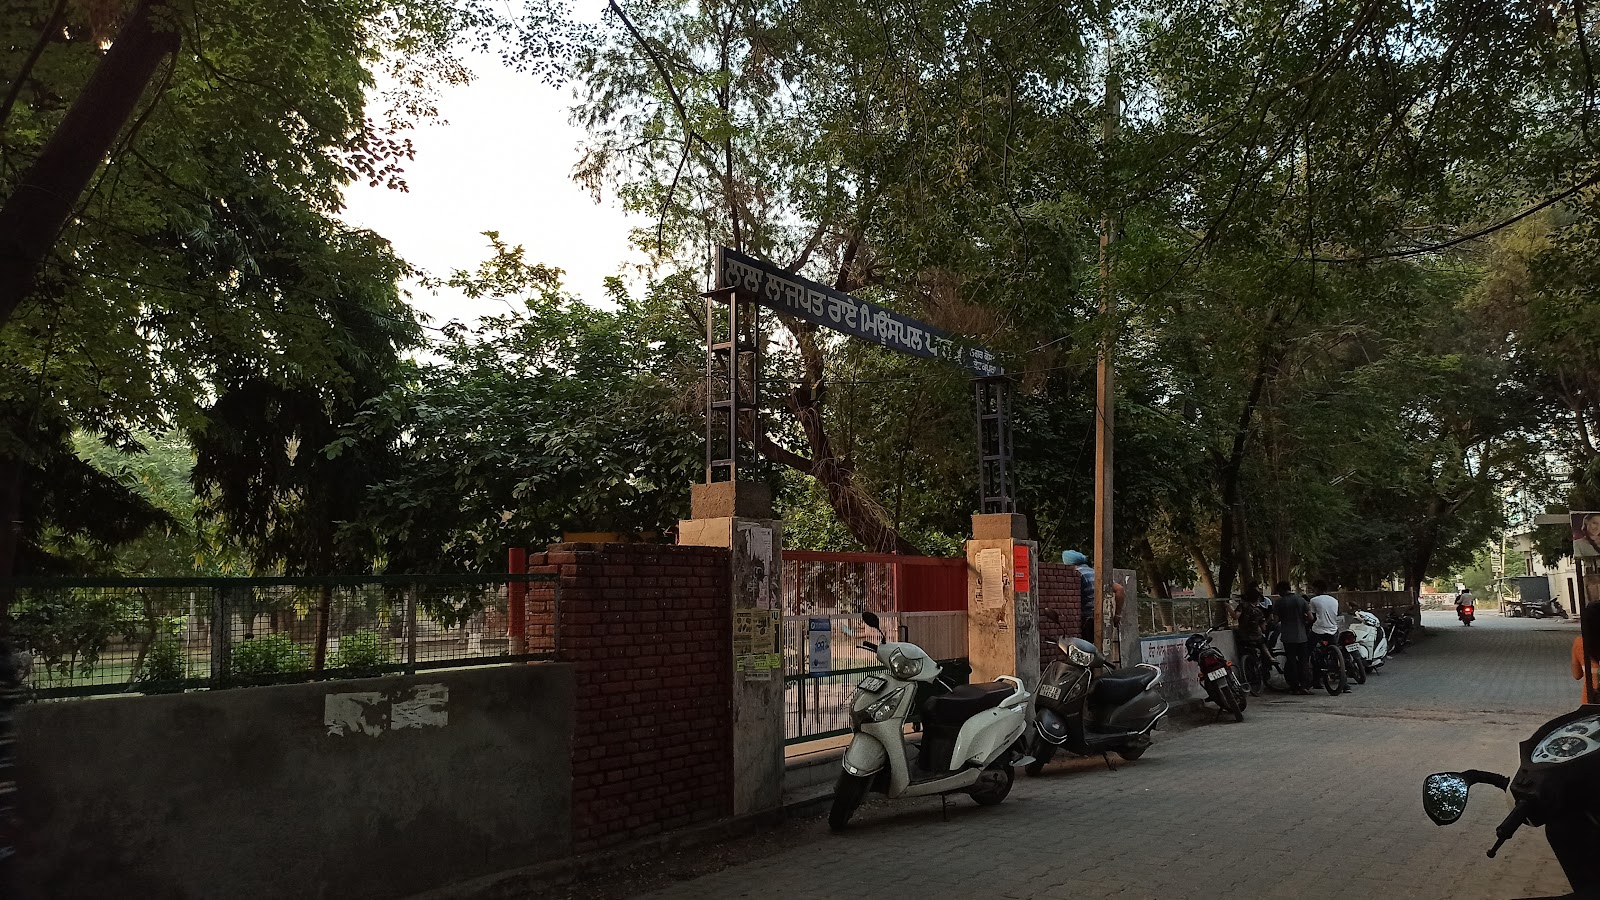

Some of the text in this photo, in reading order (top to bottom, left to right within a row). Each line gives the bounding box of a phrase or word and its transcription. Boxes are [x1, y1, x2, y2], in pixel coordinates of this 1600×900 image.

[725, 257, 764, 293] ਲਾਲਾ
[765, 272, 827, 317] ਲਾਜਪਤ
[827, 298, 859, 329] ਰਾਏ
